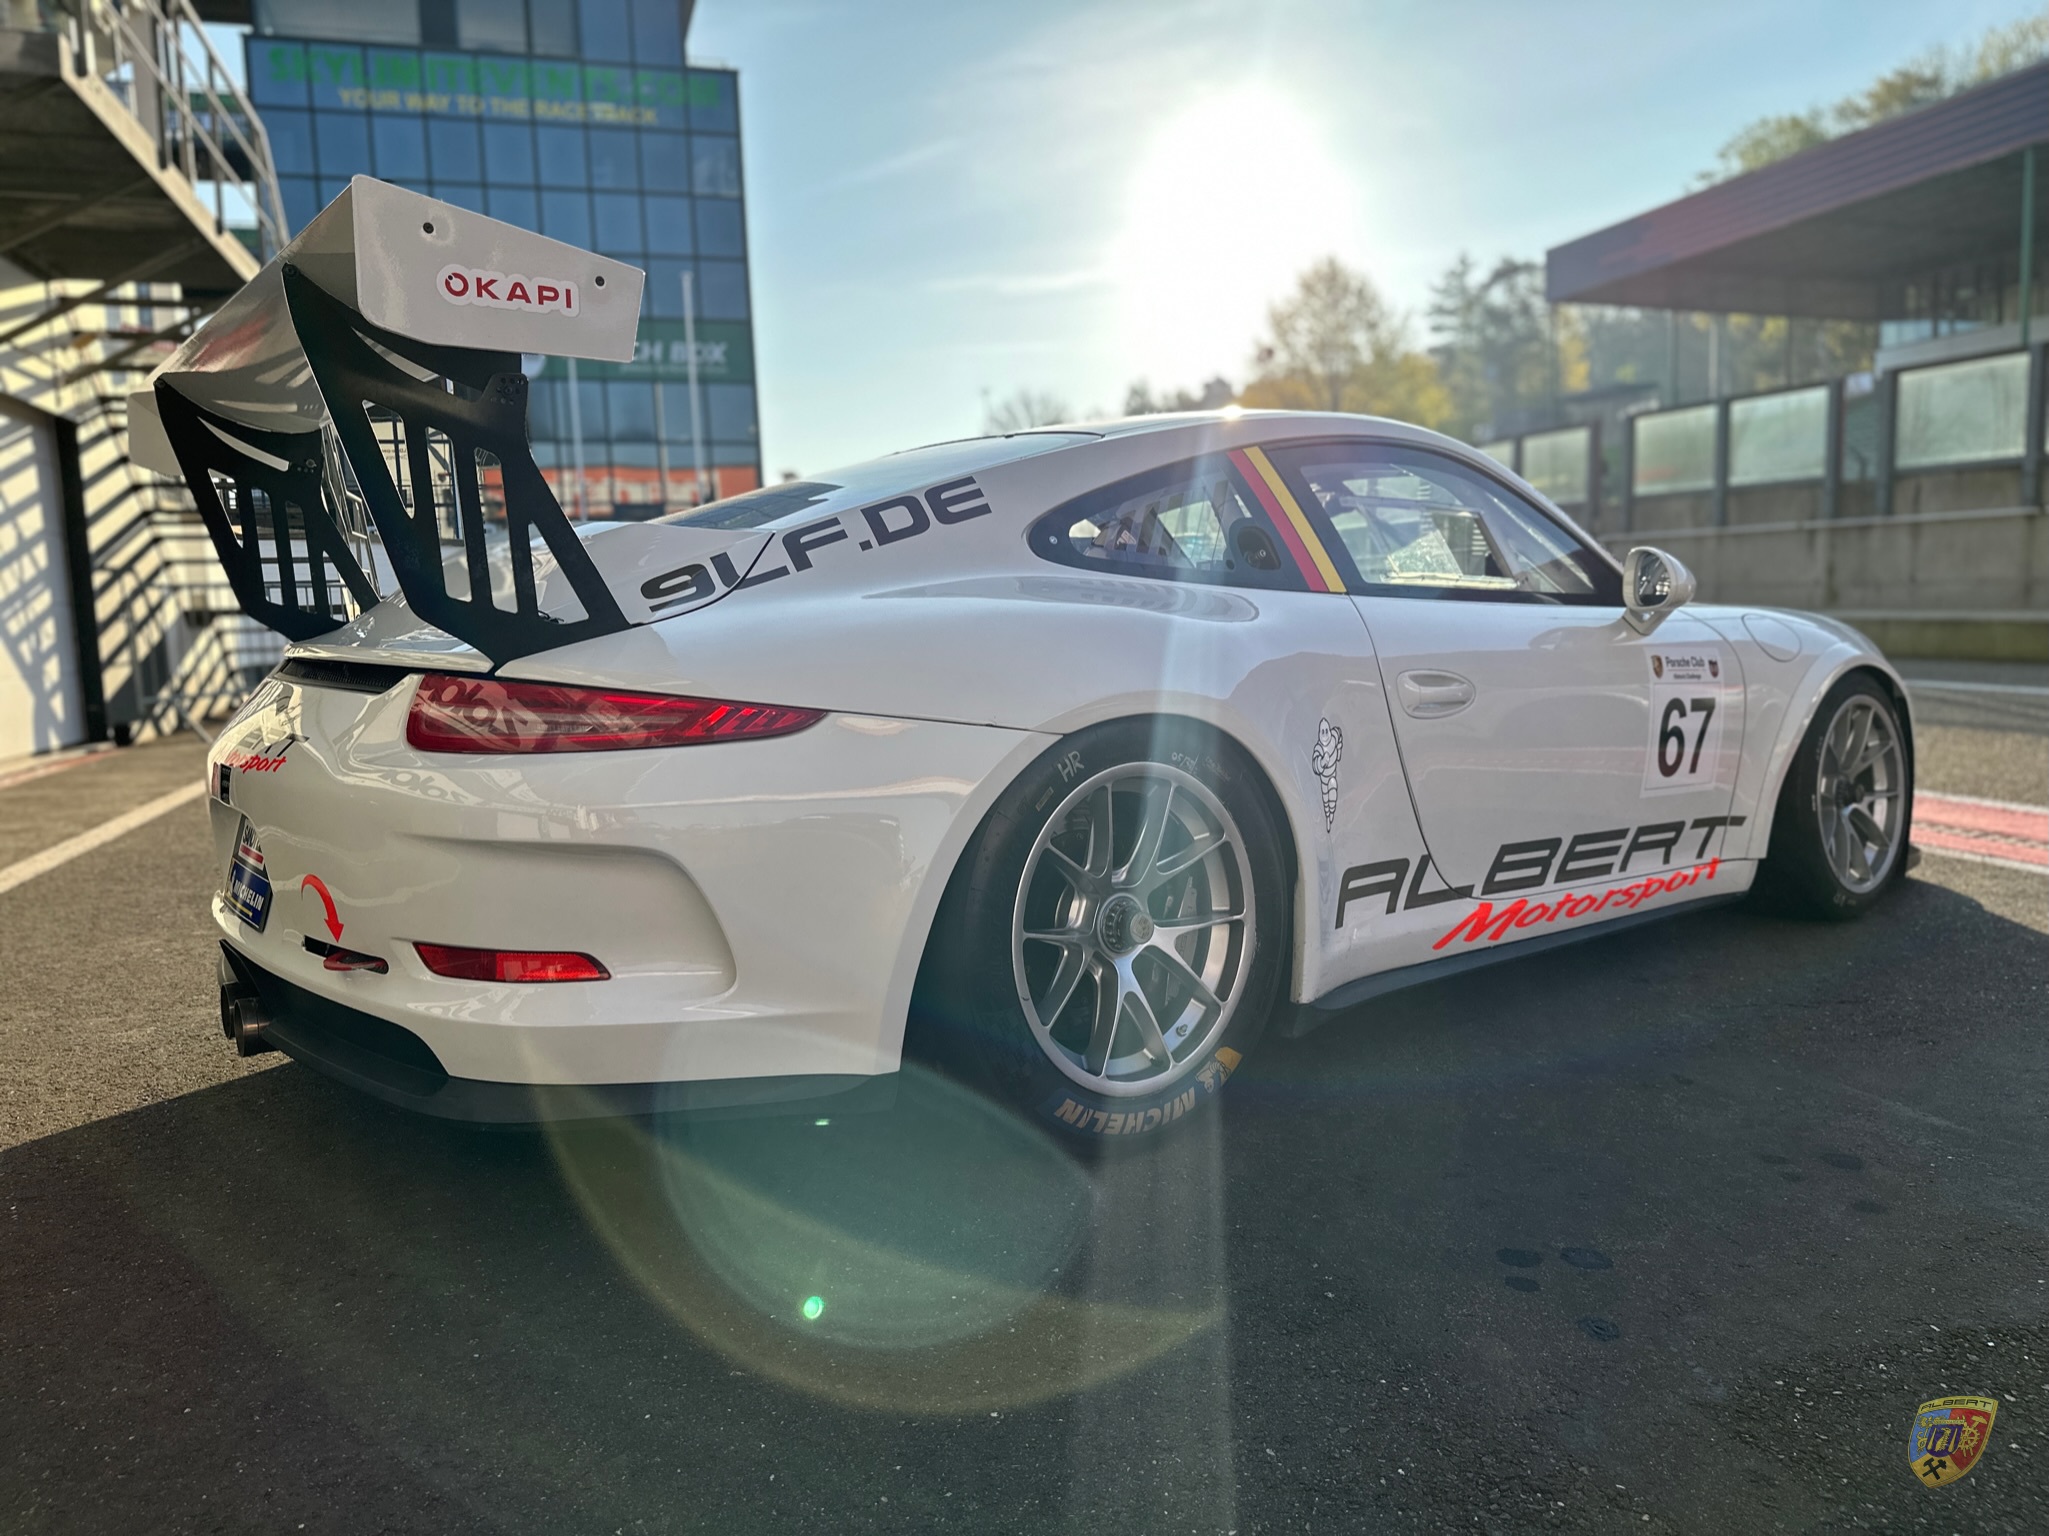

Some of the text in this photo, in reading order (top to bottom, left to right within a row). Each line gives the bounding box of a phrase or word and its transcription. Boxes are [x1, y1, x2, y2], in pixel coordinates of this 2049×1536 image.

[338, 88, 401, 110] YOUR
[405, 92, 451, 113] WAY
[456, 94, 485, 116] TO
[491, 97, 530, 118] THE
[445, 272, 572, 309] OKAPI
[640, 475, 992, 613] 9LF.DE
[1665, 655, 1705, 668] Porsche Club
[1658, 697, 1716, 778] 67
[1057, 751, 1084, 782] HR
[1335, 816, 1747, 930] ALBERT
[233, 881, 265, 912] MICHELIN
[1432, 857, 1722, 951] Motorsport
[1054, 1087, 1196, 1136] MICHELIN
